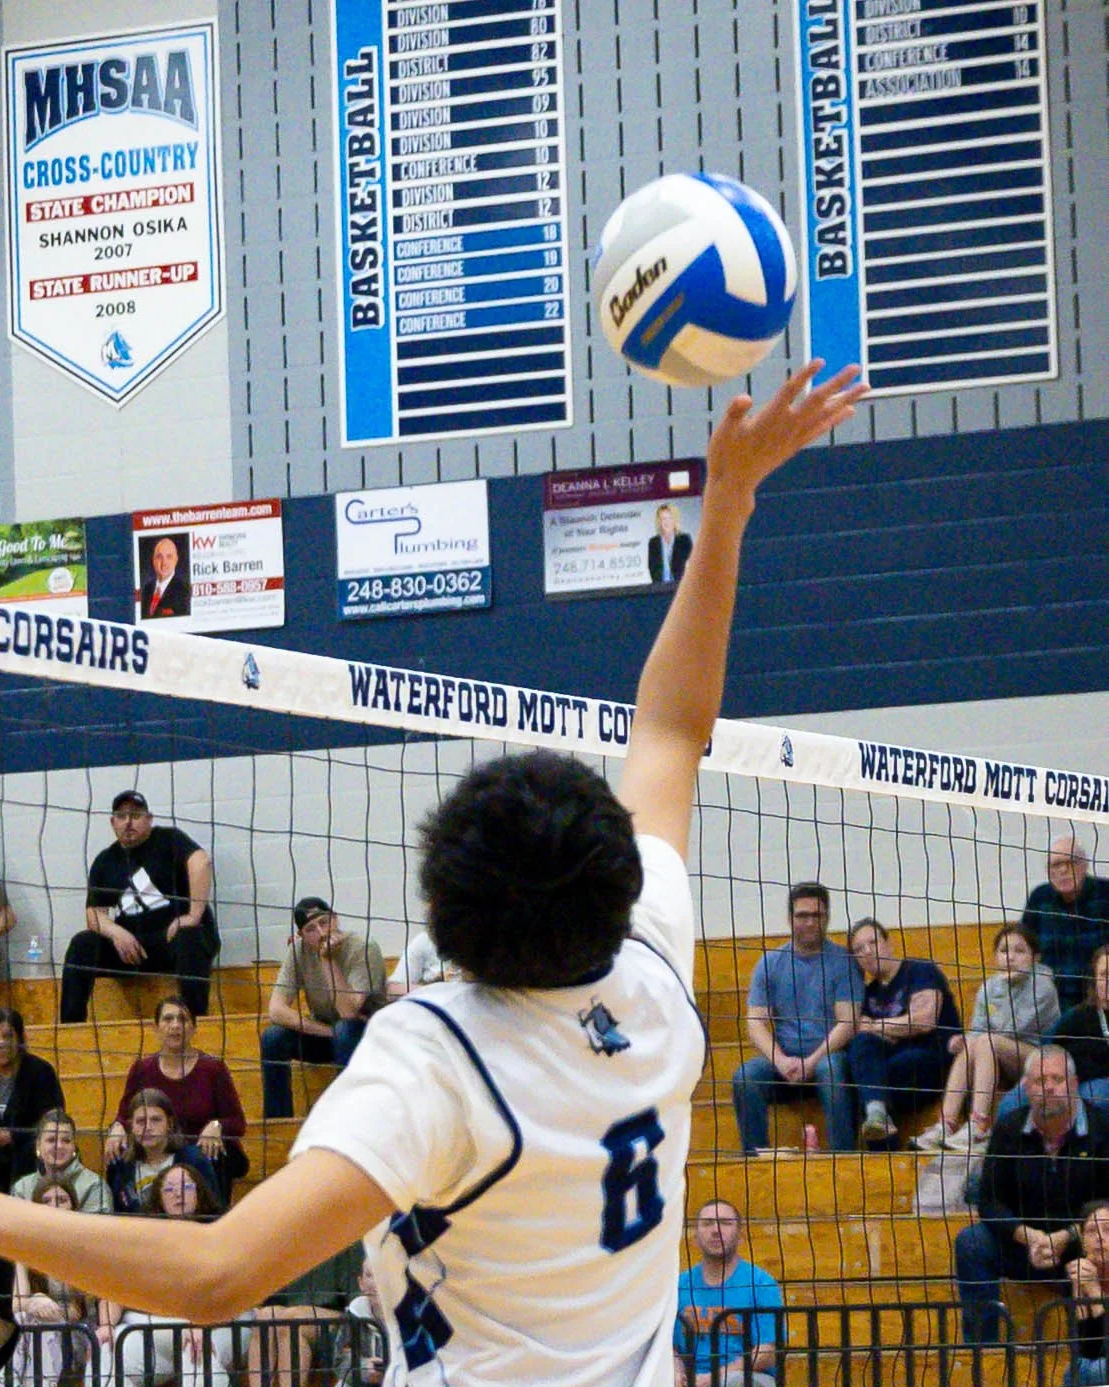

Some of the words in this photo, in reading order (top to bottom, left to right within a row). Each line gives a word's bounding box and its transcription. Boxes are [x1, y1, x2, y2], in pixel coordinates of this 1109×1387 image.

[397, 5, 449, 27] DIVISION
[397, 29, 449, 52] DIVISION
[398, 55, 450, 78] DISTRICT
[865, 43, 950, 71] CONFERENCE
[398, 80, 450, 104] DIVISION
[865, 68, 962, 98] ASSOCIATION
[24, 50, 198, 151] MHSAA
[399, 105, 450, 129] DIVISION
[400, 131, 451, 155] DIVISION
[534, 120, 548, 138] 10
[809, 0, 849, 277] BASKETBALL
[23, 142, 199, 189] CROSS-COUNTRY
[401, 154, 478, 179] CONFERENCE
[535, 147, 549, 164] 10
[30, 201, 84, 221] STATE
[91, 184, 192, 214] CHAMPION
[346, 49, 381, 330] BASKETBALL
[402, 184, 453, 207] DIVISION
[537, 172, 550, 190] 12
[403, 210, 454, 233] DISTRICT
[538, 199, 552, 217] 12
[39, 224, 125, 248] SHANNON
[133, 217, 188, 237] OSIKA
[397, 236, 464, 258] CONFERENCE
[94, 243, 133, 261] 2007
[33, 278, 84, 299] STATE
[90, 263, 195, 292] RUNNER-UP
[397, 261, 464, 283] CONFERENCE
[95, 300, 136, 318] 2008
[398, 286, 465, 308] CONFERENCE
[399, 312, 466, 333] CONFERENCE
[545, 303, 559, 318] 22
[552, 479, 601, 494] DEANNA
[613, 473, 655, 488] KELLEY
[32, 535, 46, 551] To
[394, 528, 479, 556] Plumbing
[193, 562, 219, 576] Rick
[223, 558, 264, 575] Barren
[348, 571, 482, 602] 248-830-0362
[349, 664, 508, 727] WATERFORD
[517, 690, 588, 739] MOTT
[858, 742, 977, 794] WATERFORD
[983, 761, 1037, 803] MOTT
